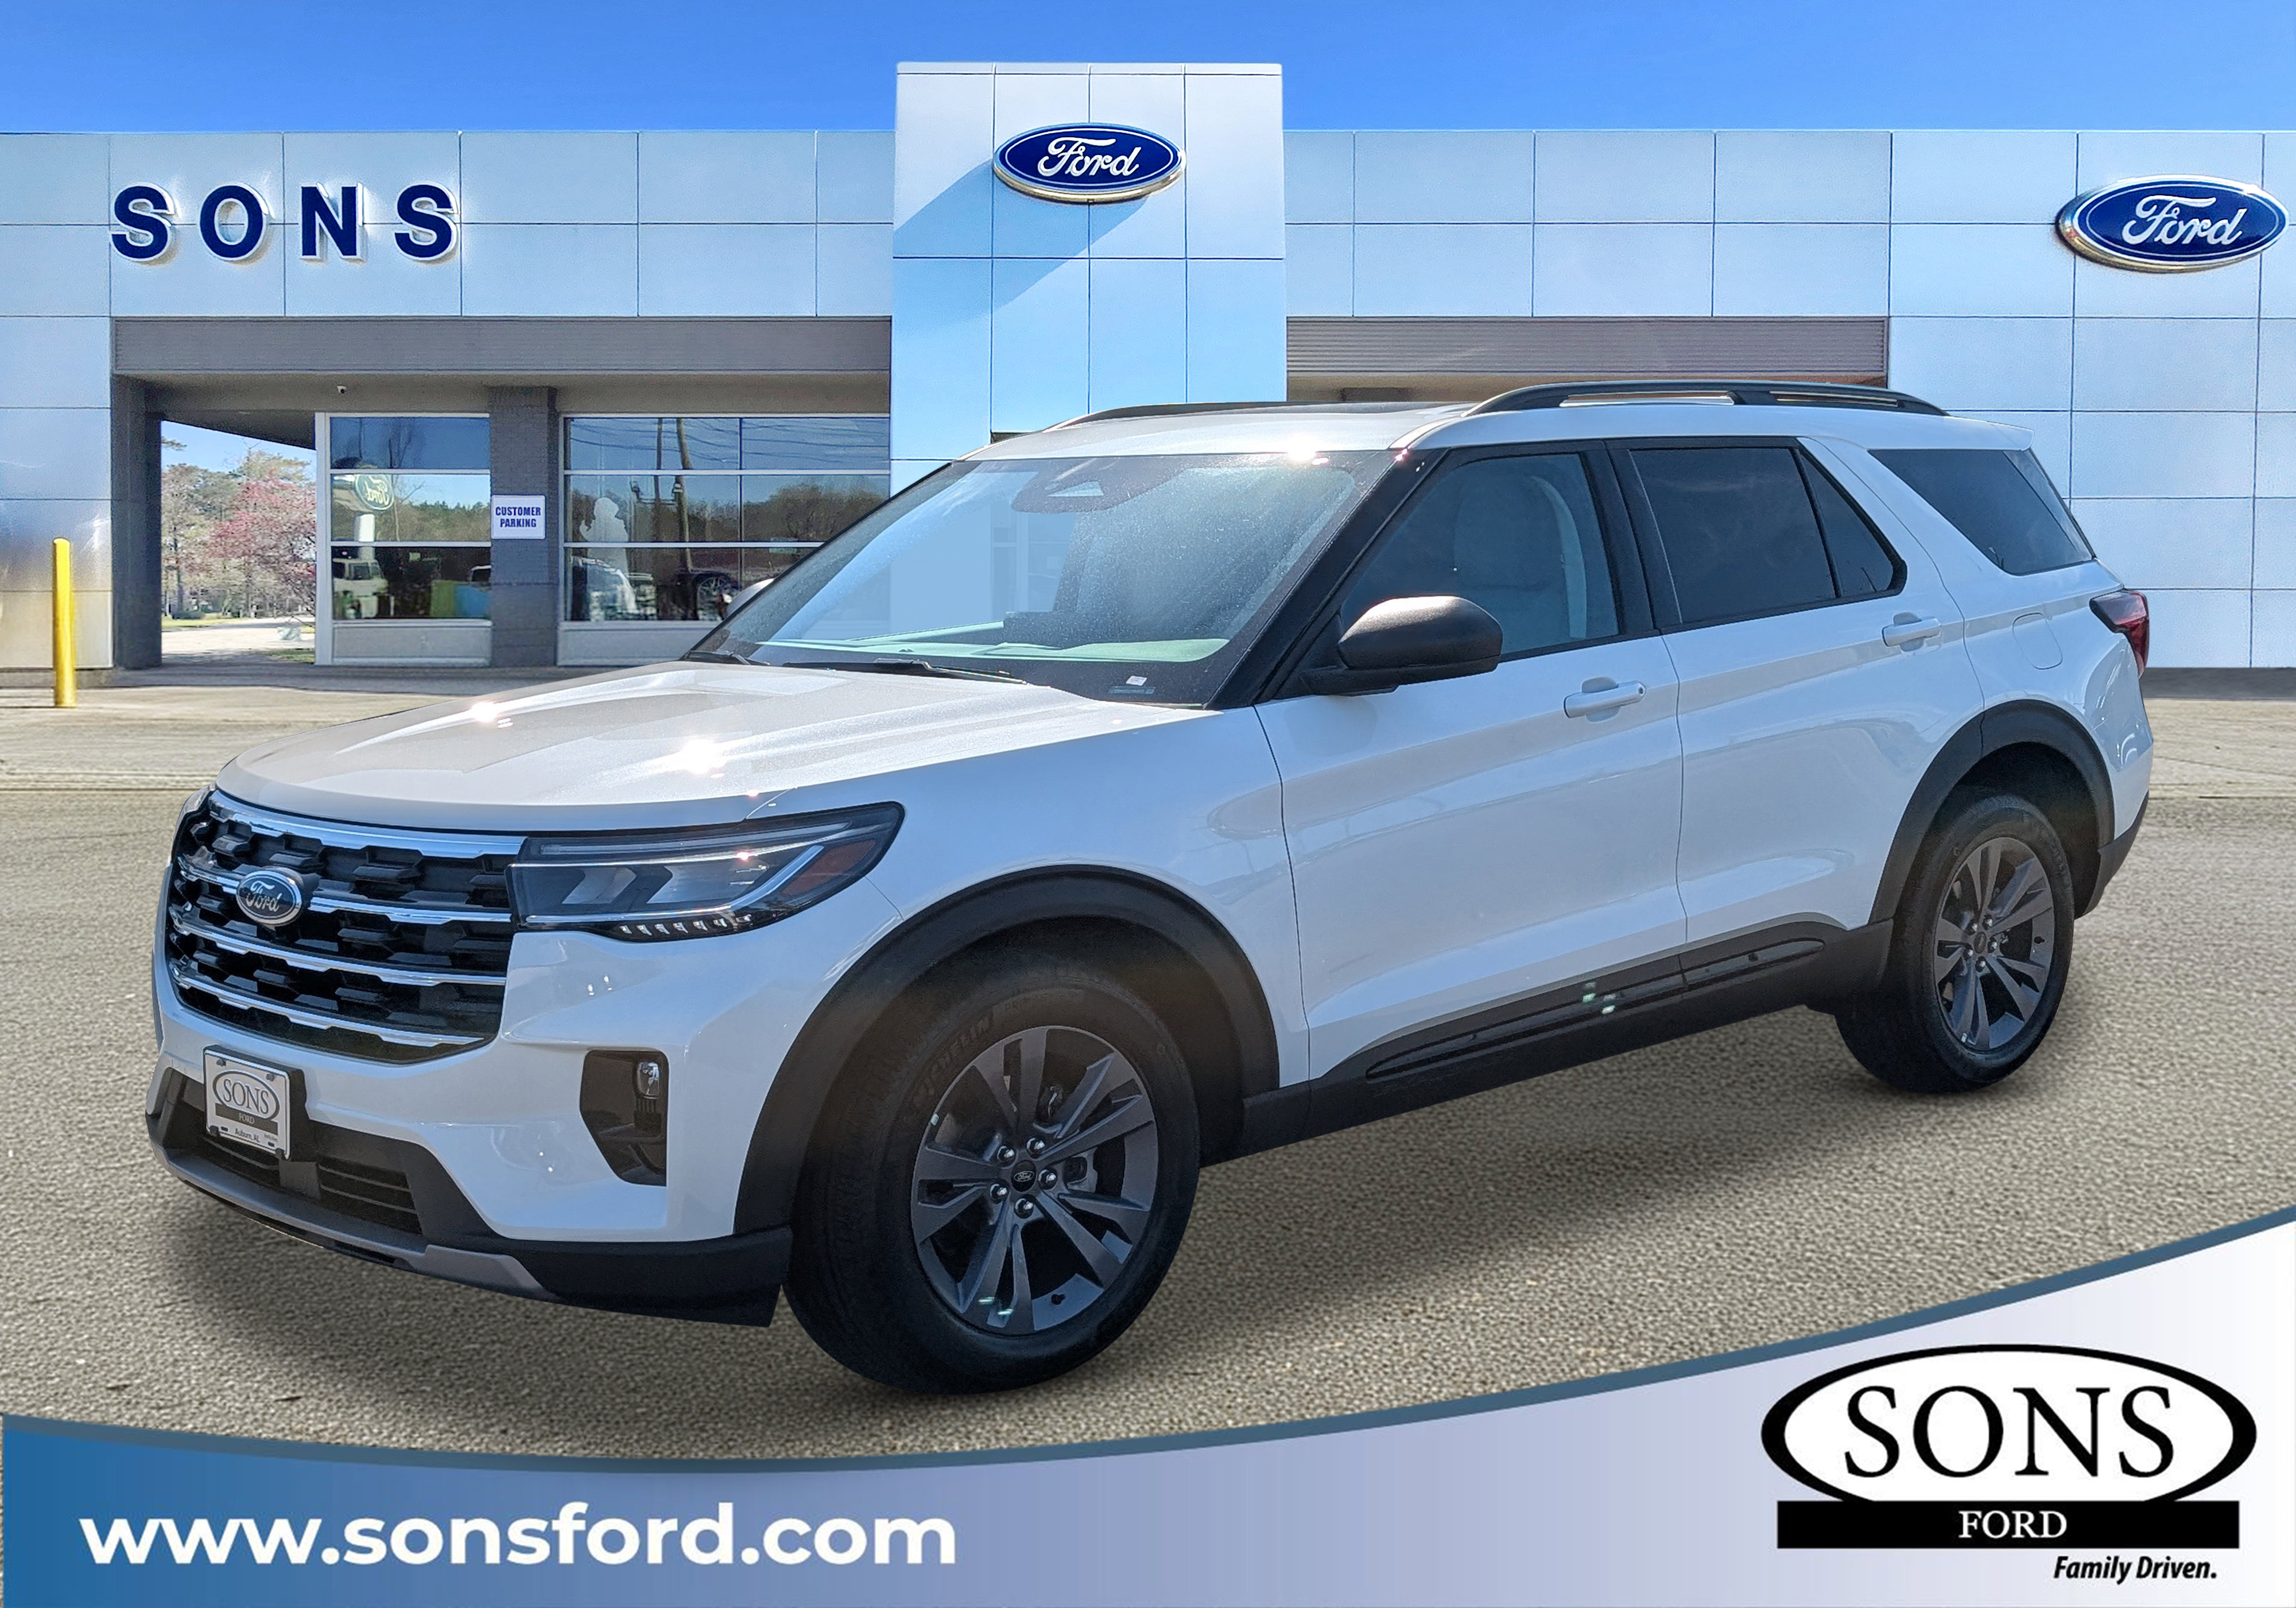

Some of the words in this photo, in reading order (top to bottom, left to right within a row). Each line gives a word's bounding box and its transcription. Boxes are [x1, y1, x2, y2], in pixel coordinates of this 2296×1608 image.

[1037, 137, 1142, 177] Ford
[111, 184, 456, 259] SONS
[2122, 195, 2247, 245] Ford
[495, 507, 541, 516] CUSTOMER
[500, 519, 537, 527] PARKING
[246, 880, 282, 912] Ford
[223, 1079, 269, 1114] SONS
[239, 1113, 255, 1125] FORD
